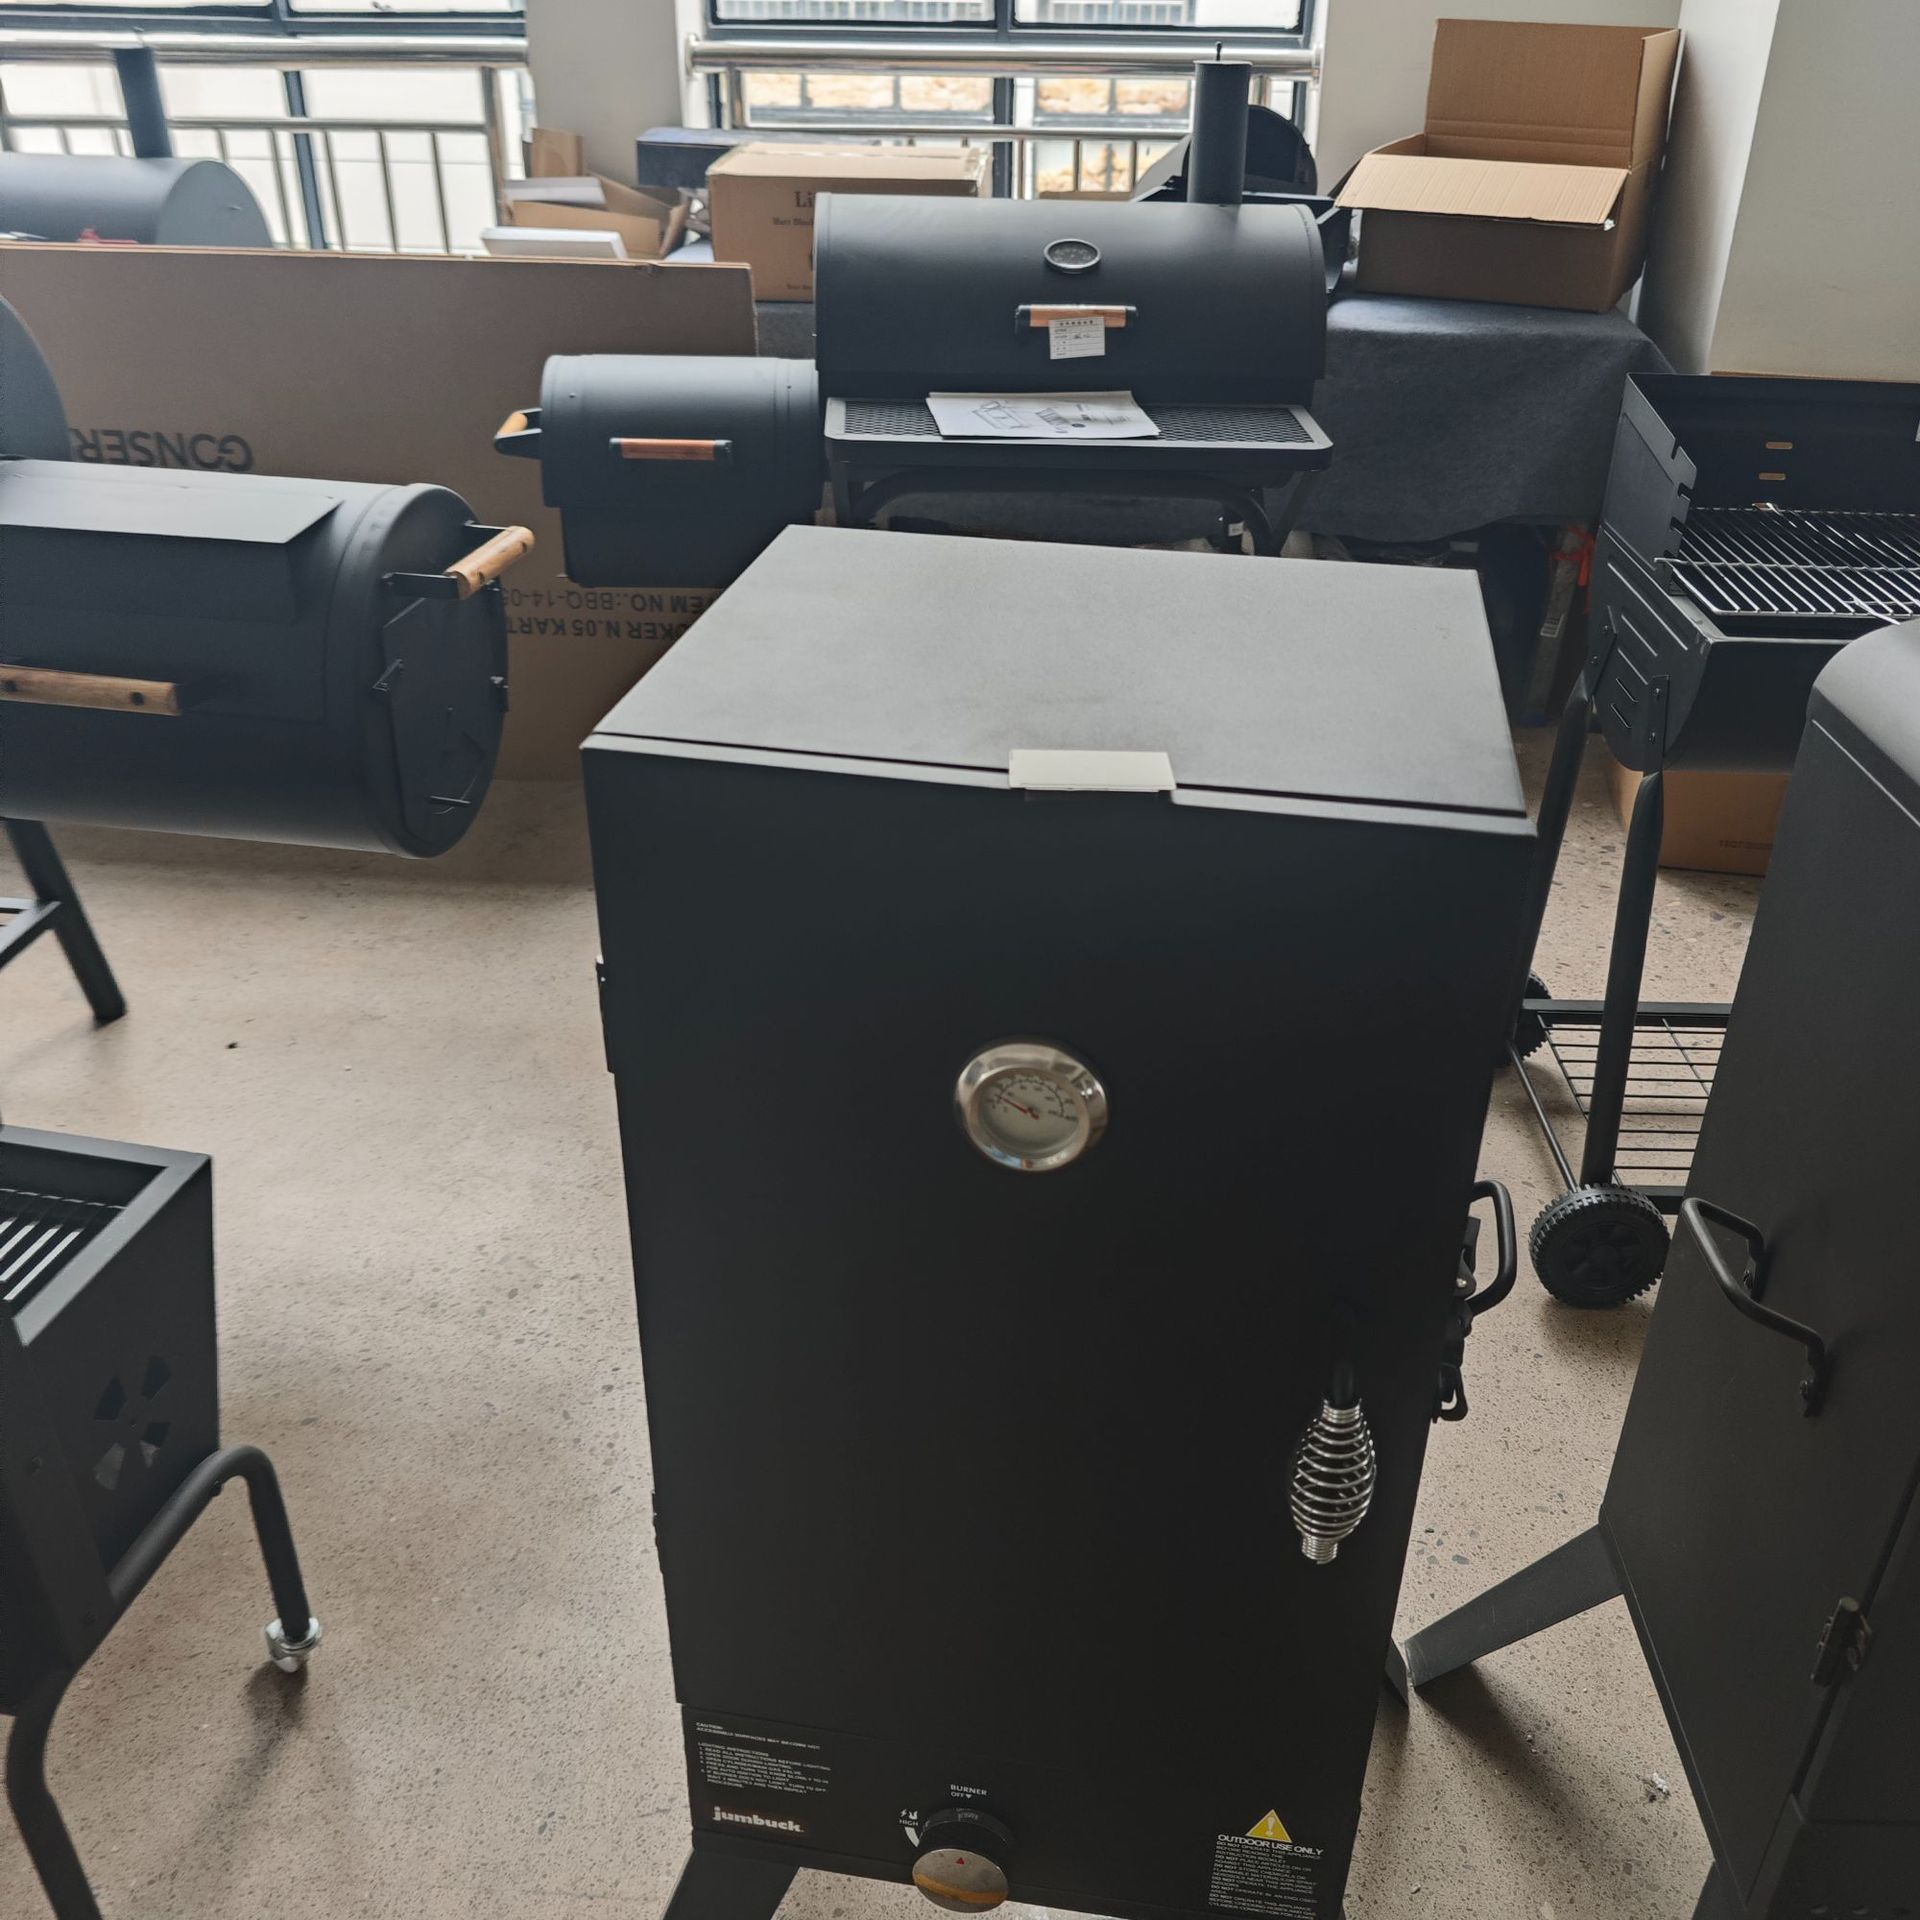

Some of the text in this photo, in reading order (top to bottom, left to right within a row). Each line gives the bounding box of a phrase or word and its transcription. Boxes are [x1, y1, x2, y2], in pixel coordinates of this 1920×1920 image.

[950, 1784, 987, 1796] BURNER
[712, 1806, 801, 1832] jumbuck
[898, 1818, 919, 1826] HIGH
[1217, 1834, 1324, 1855] OUTDOOR USE ONLY
